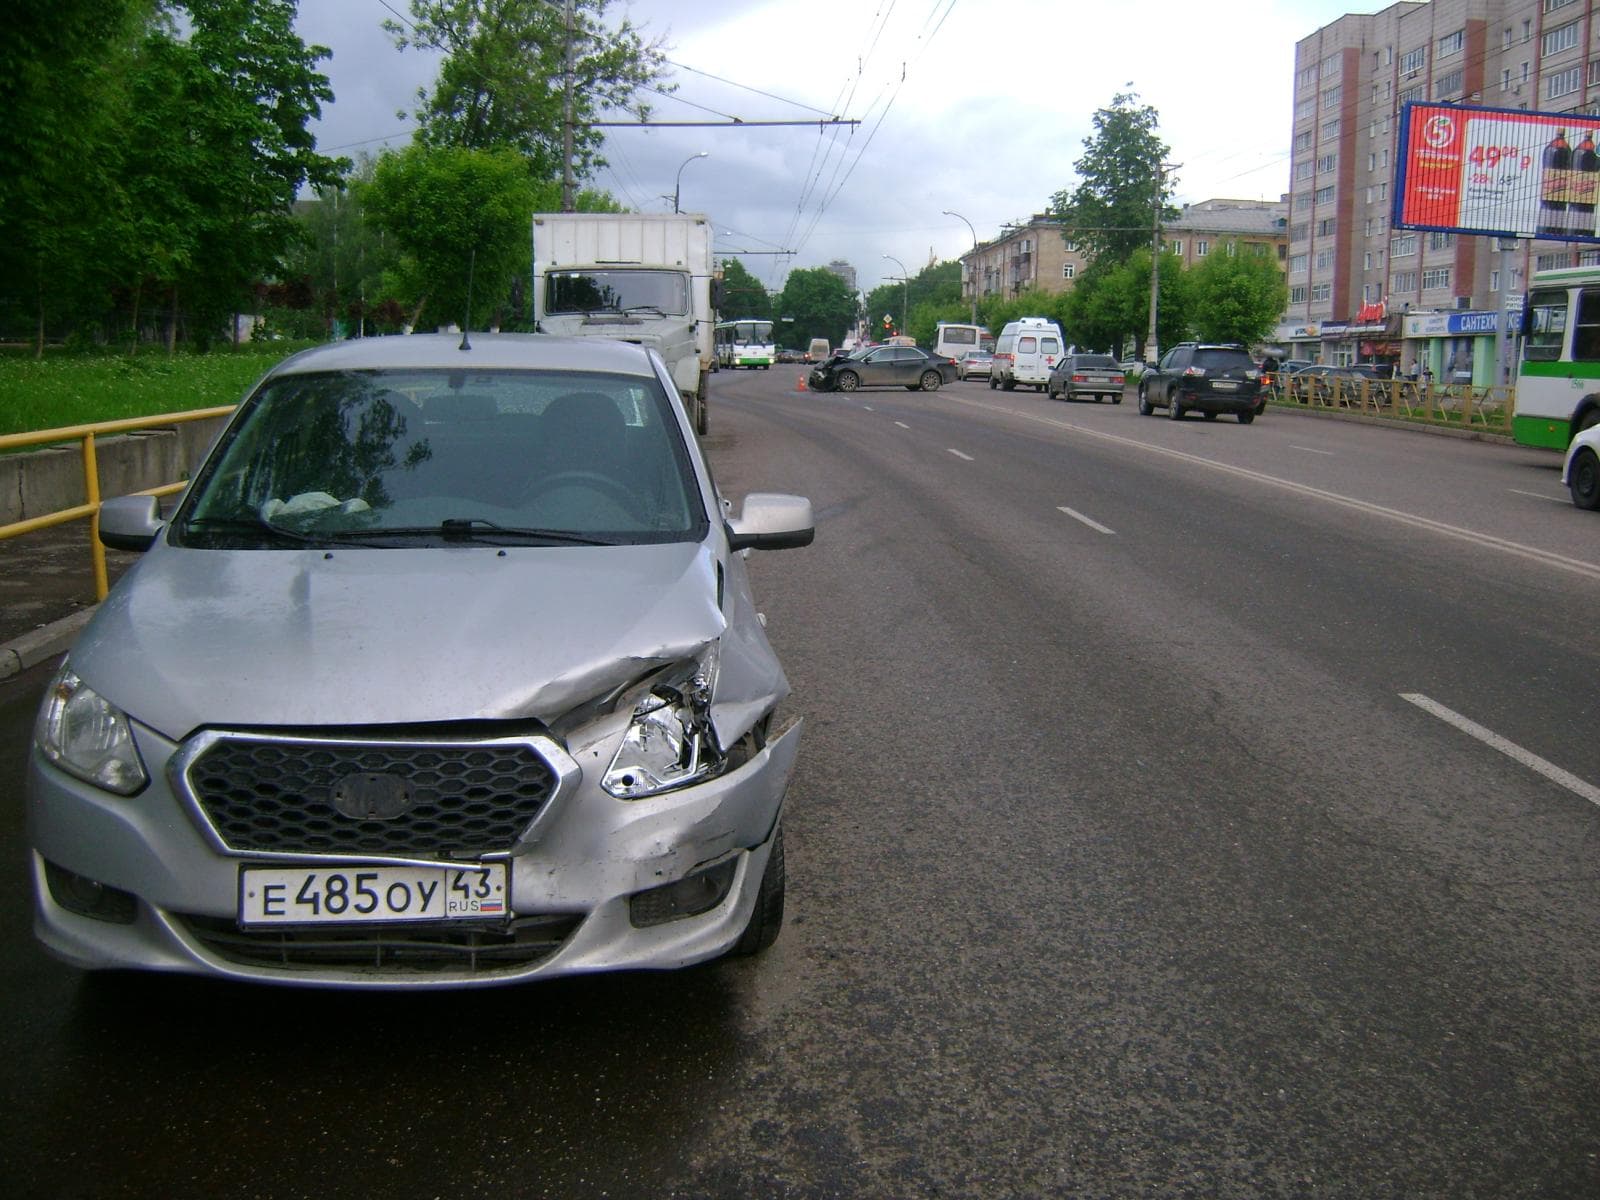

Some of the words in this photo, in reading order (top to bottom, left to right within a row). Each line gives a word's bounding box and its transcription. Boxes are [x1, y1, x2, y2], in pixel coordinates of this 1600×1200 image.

[1469, 145, 1500, 168] 49
[263, 873, 438, 916] Е485ОУ
[451, 868, 491, 899] 43
[448, 900, 479, 912] RUS
